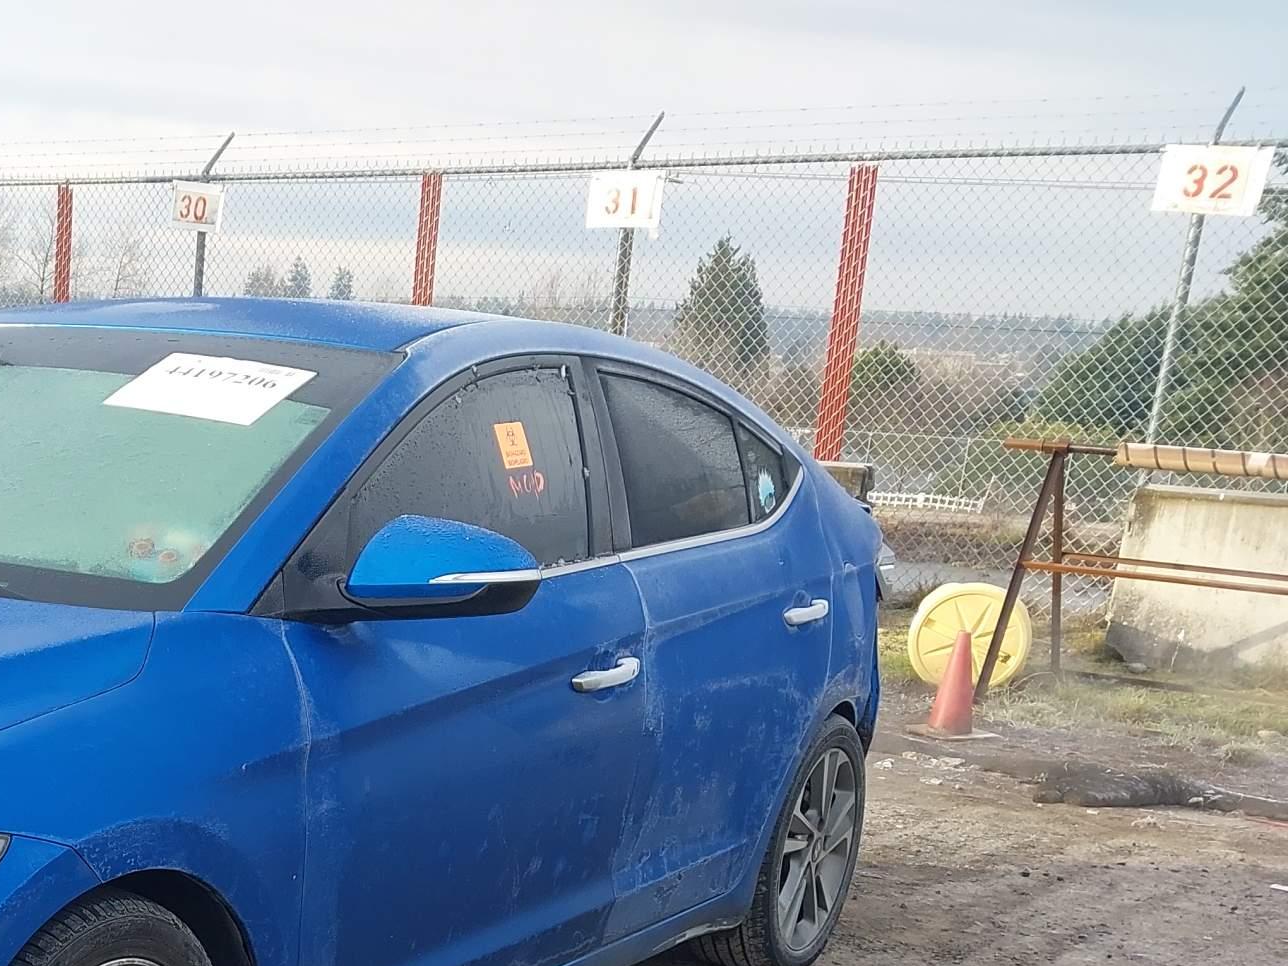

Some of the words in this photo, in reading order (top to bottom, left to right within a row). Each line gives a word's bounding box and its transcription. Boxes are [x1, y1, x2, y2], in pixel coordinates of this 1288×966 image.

[1183, 164, 1239, 199] 32
[179, 194, 207, 221] 30
[604, 187, 638, 215] 31
[167, 365, 278, 389] 44197206
